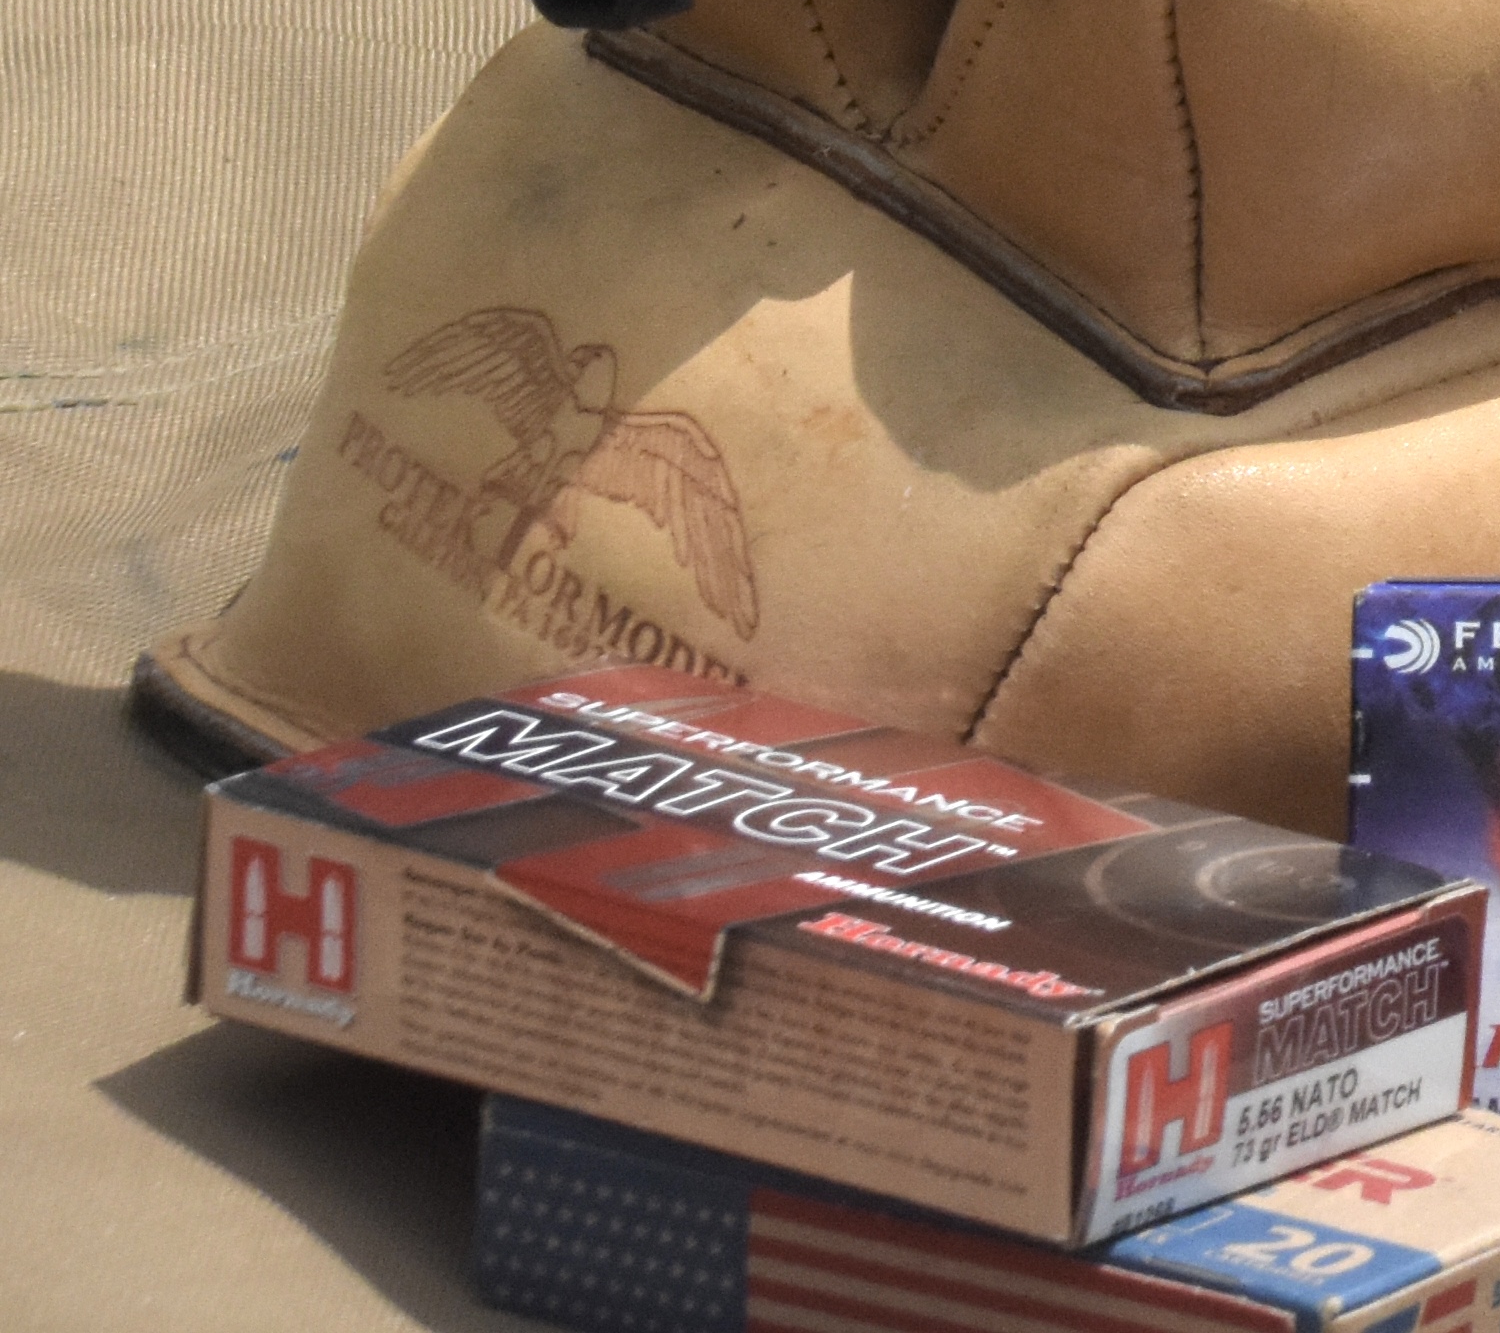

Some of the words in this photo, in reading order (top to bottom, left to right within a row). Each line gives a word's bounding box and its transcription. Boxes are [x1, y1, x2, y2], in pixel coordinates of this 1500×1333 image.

[596, 593, 751, 687] MODE
[537, 690, 1045, 834] SUPERFORMANCE
[792, 869, 1014, 933] AMMUNITION
[796, 910, 1092, 1000] Hornady
[1258, 937, 1442, 1024] SUPERFORMANCE
[1236, 1090, 1284, 1135] 5.56
[1288, 1067, 1359, 1116] NATO
[1348, 1077, 1424, 1125] MATCH
[1221, 1224, 1376, 1277] 20
